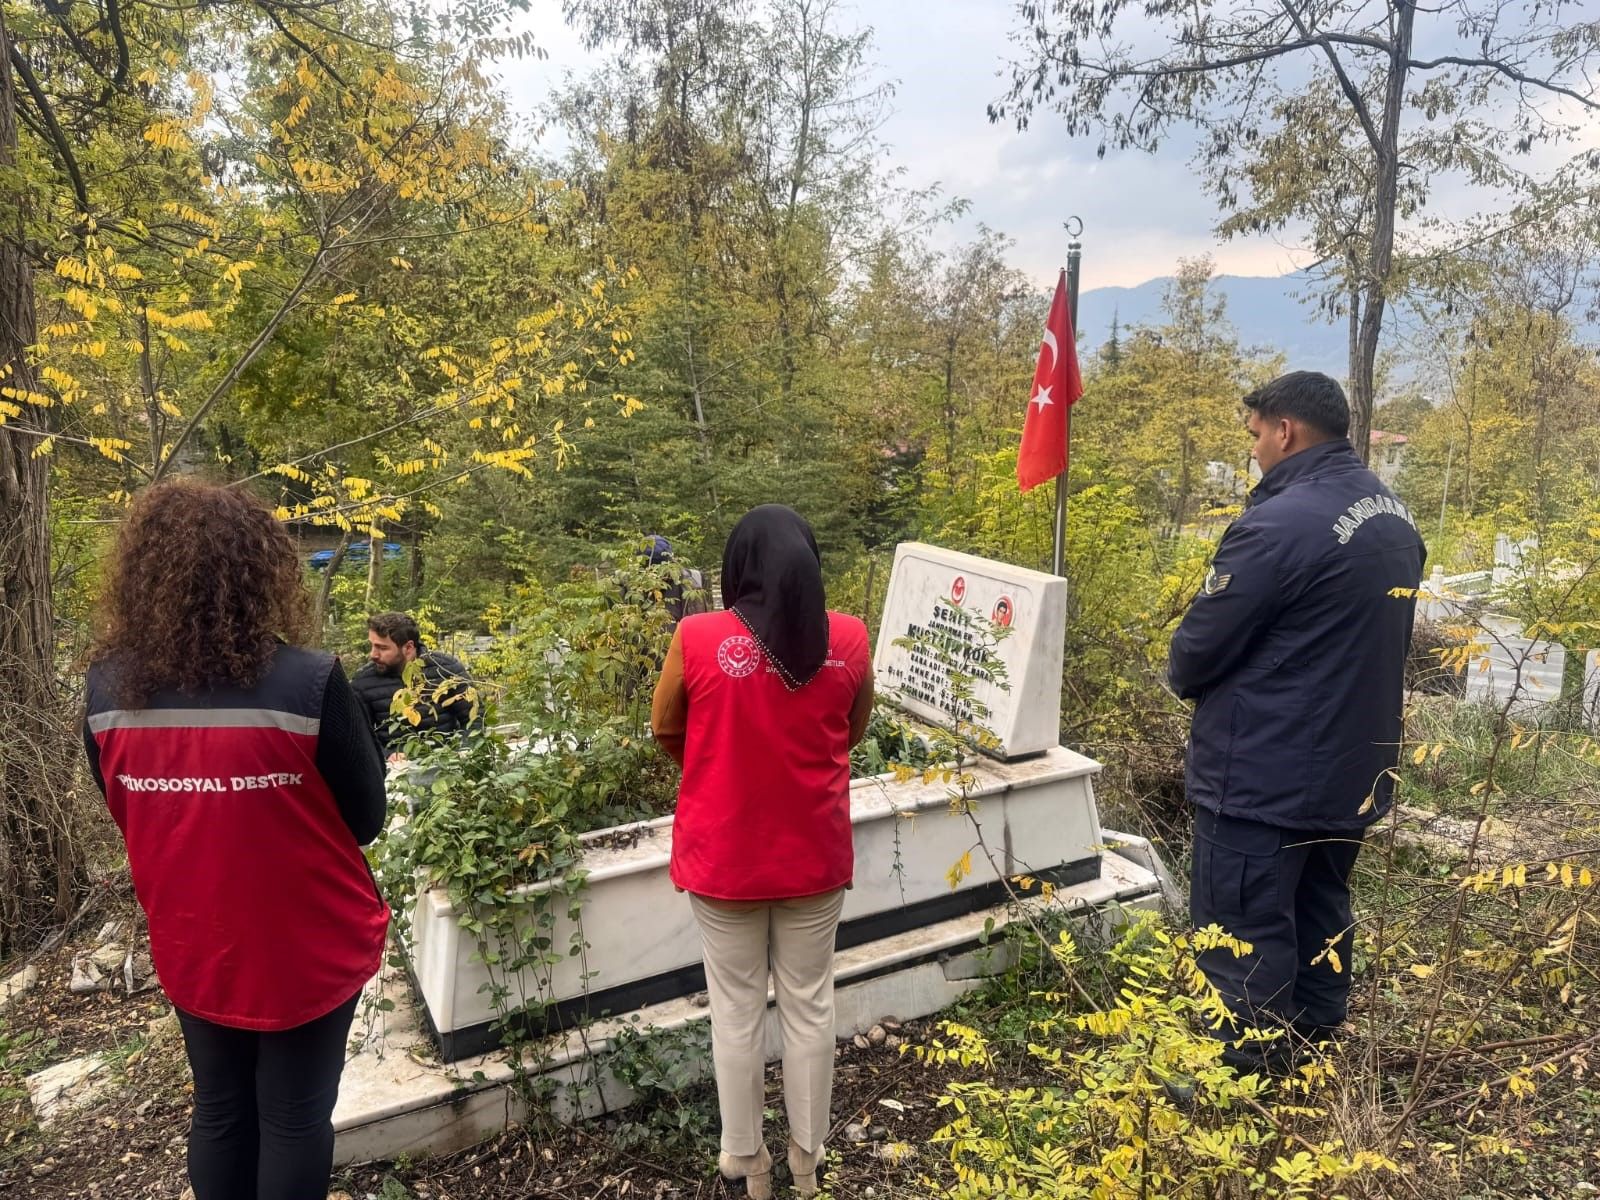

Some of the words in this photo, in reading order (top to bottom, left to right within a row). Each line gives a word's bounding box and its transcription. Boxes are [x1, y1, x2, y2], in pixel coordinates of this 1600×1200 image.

[1332, 494, 1417, 545] JANDARMA
[909, 665, 929, 679] ANNE
[231, 772, 304, 791] DESTEK
